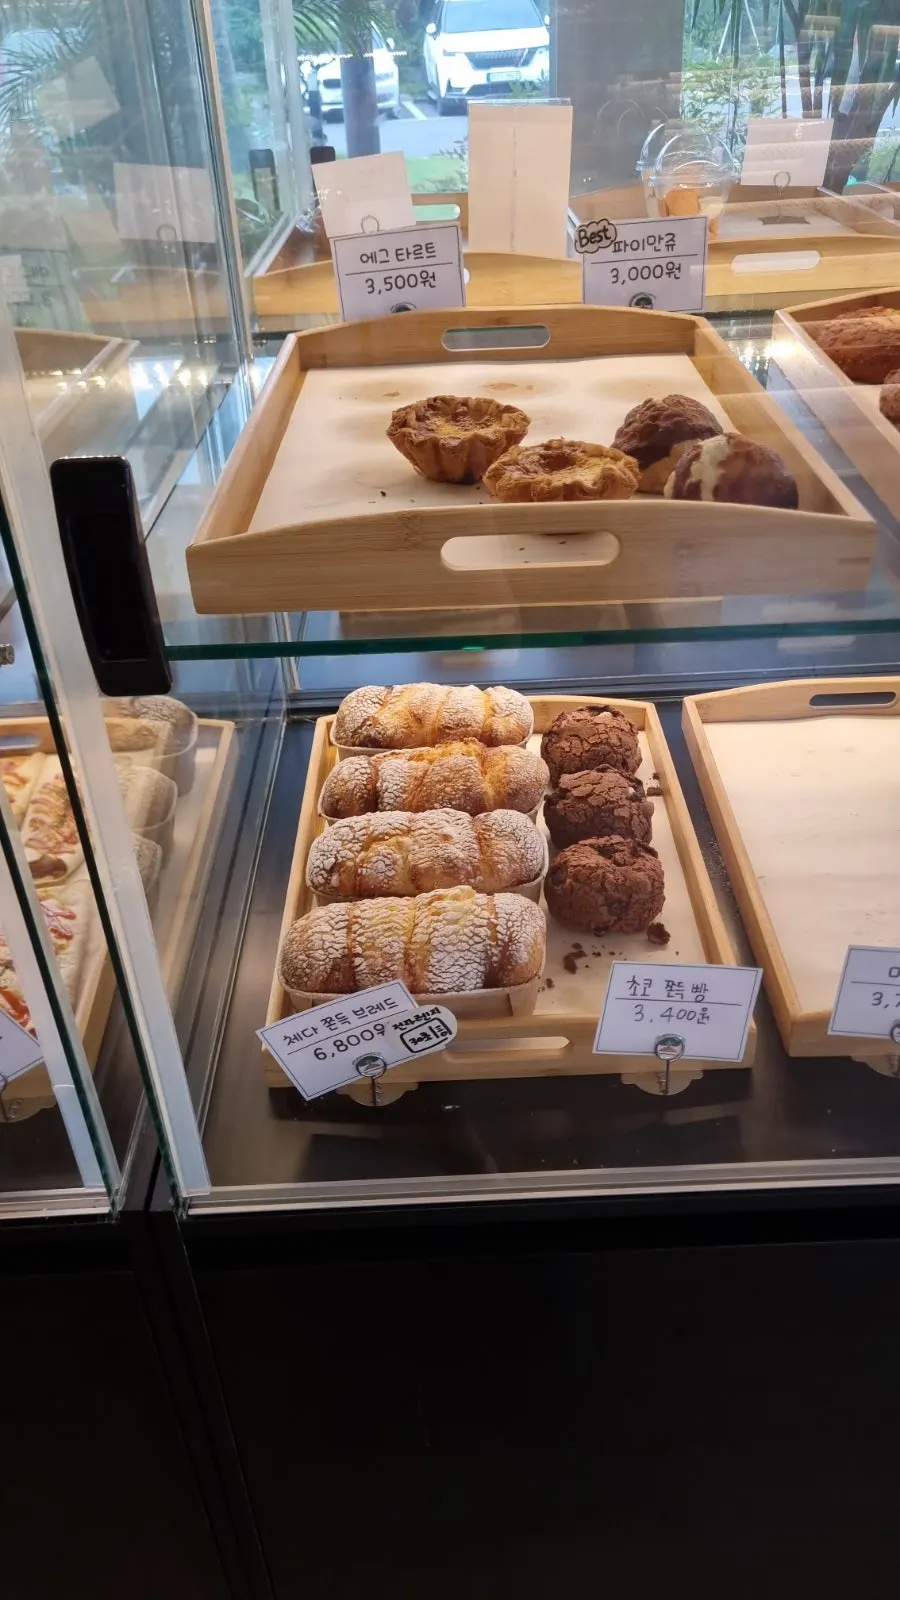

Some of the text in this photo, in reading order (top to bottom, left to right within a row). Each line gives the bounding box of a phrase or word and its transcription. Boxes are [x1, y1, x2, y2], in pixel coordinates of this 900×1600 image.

[577, 225, 613, 249] Best
[611, 232, 677, 254] 파이만쥬
[359, 242, 437, 265] 에그 타르트
[365, 270, 437, 295] 3,500원
[610, 261, 682, 286] 3,000원
[626, 975, 653, 997] 초코
[283, 1026, 319, 1047] 체다
[352, 996, 400, 1020] 브레드
